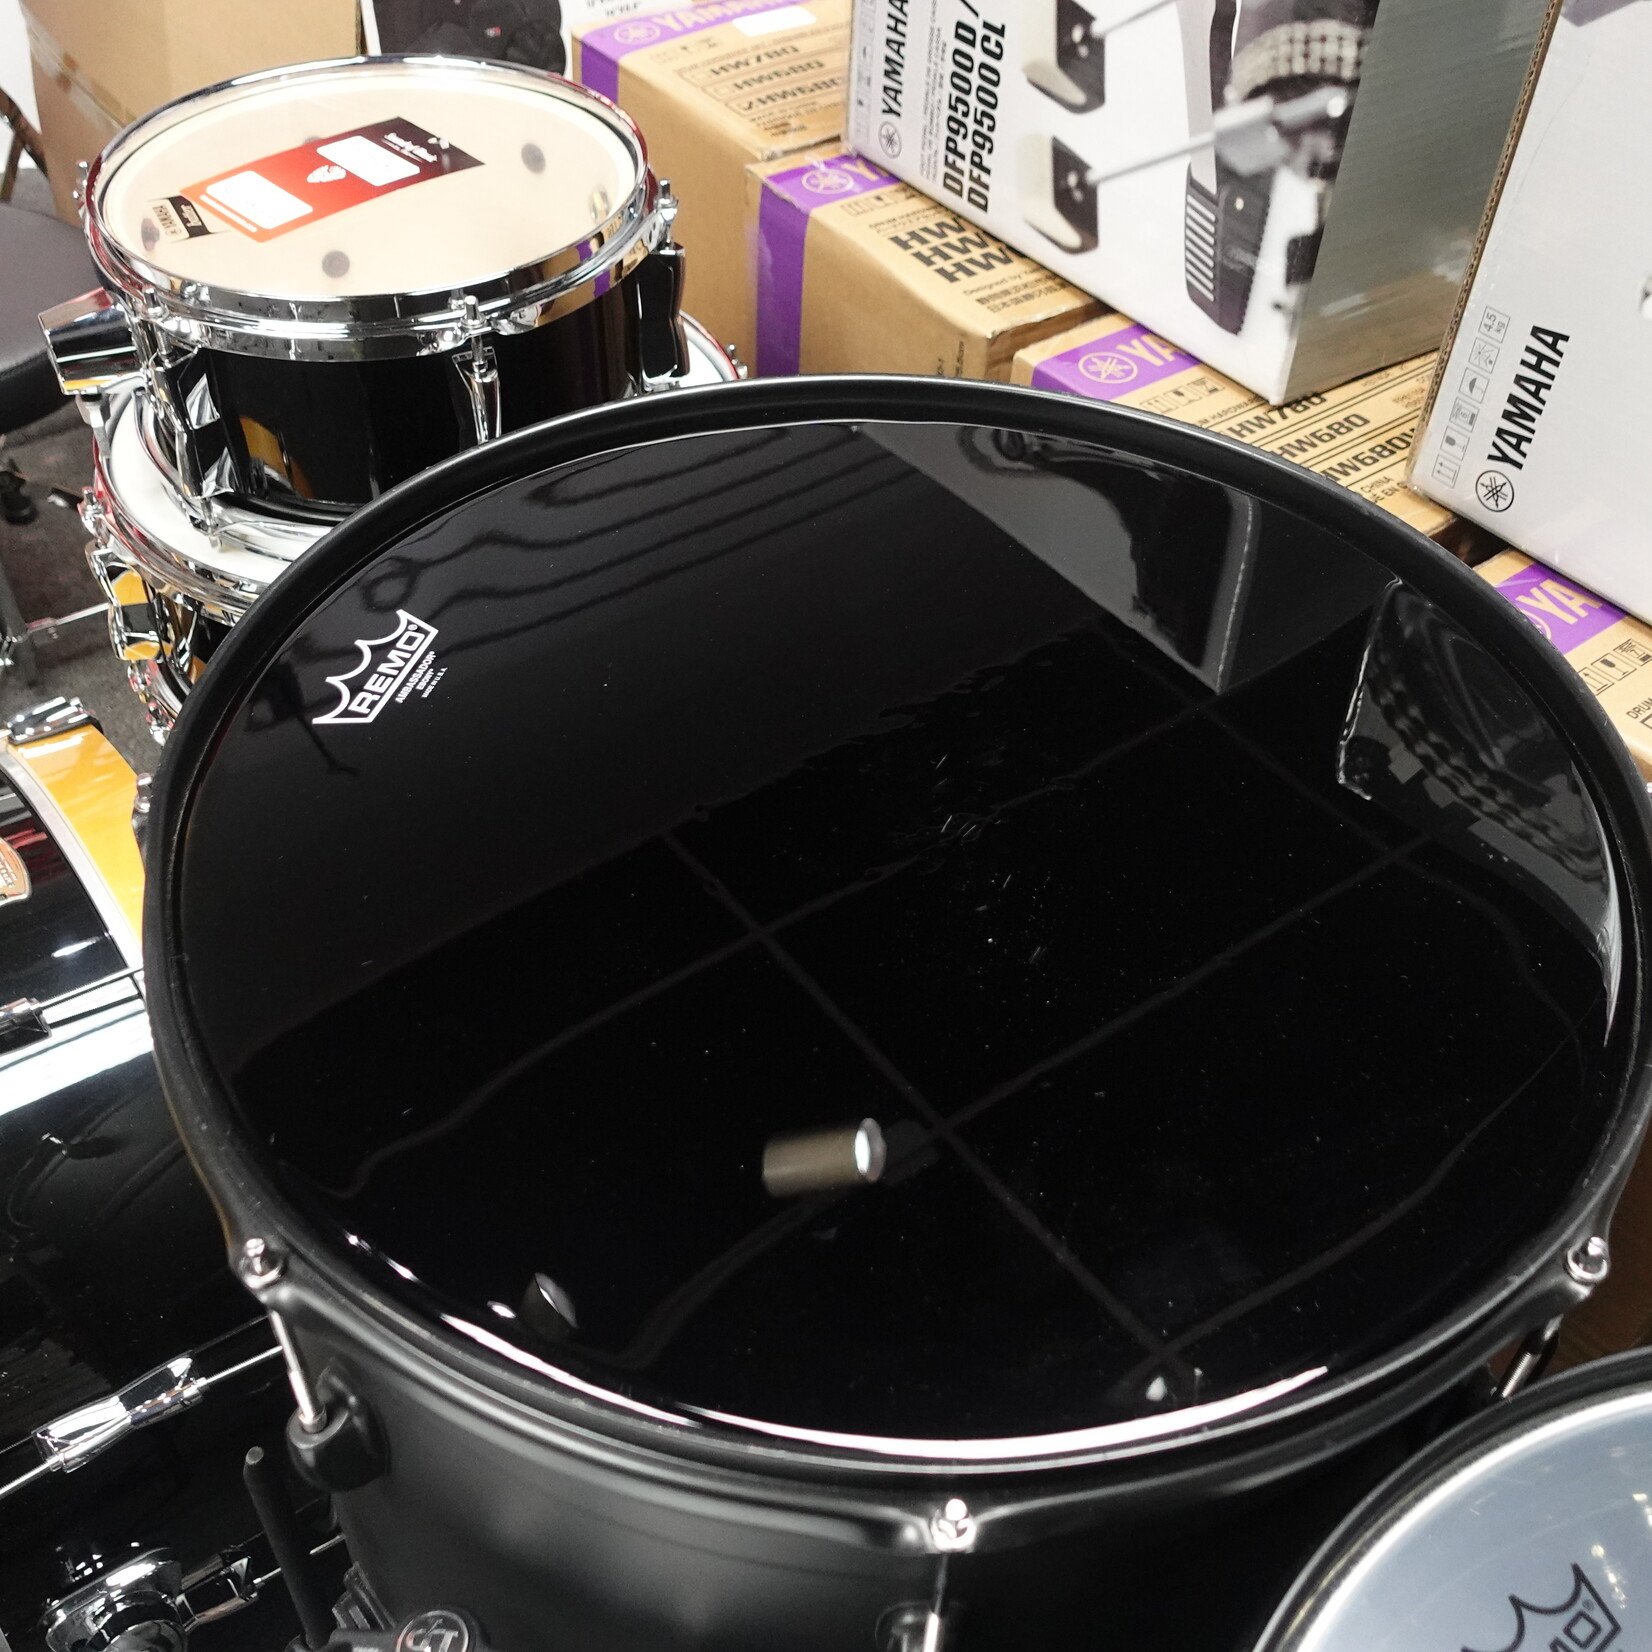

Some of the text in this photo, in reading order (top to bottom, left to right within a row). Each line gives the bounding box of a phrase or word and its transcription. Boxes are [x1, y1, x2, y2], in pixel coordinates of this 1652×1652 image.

[709, 45, 800, 76] HW780
[733, 59, 826, 91] HW680
[881, 0, 909, 118] YAMAHA
[943, 20, 977, 199] DFP9500D
[967, 19, 1006, 213] DFP9500CL
[1487, 325, 1570, 470] YAMAHA
[1270, 413, 1371, 458] HW680
[1320, 427, 1416, 481] HW680
[348, 631, 425, 714] REMO
[395, 653, 437, 704] AMBASSADOR
